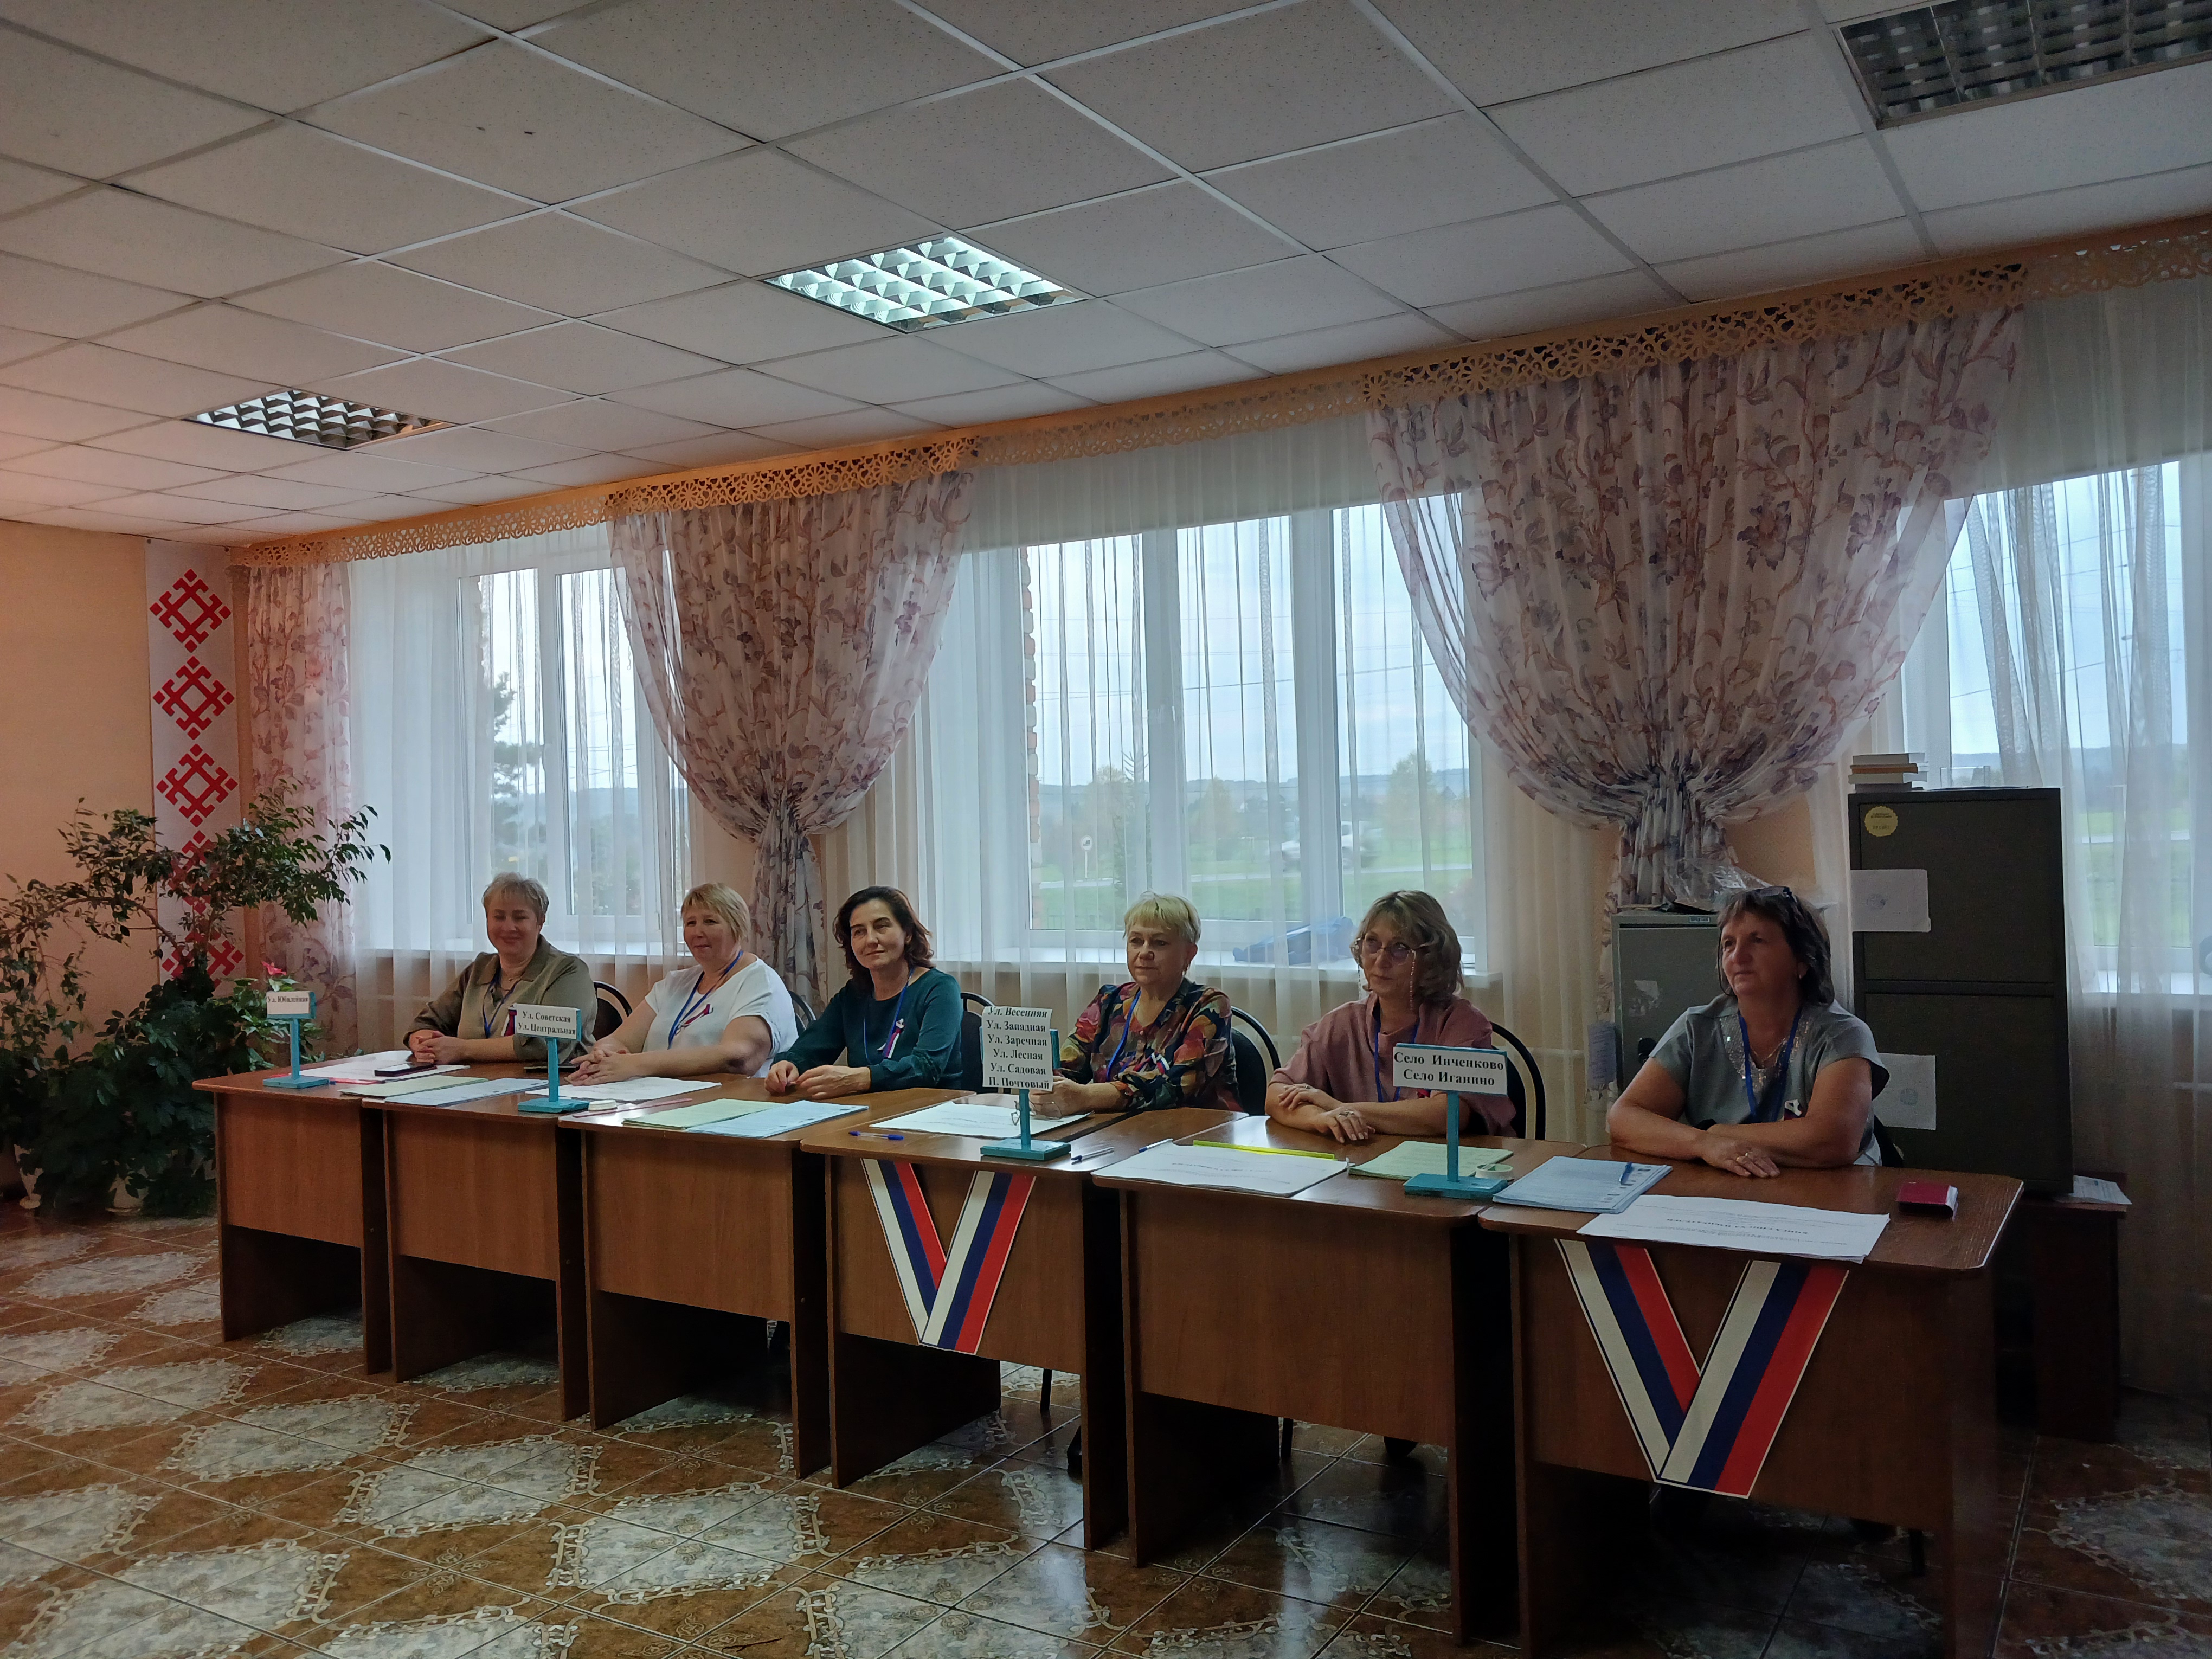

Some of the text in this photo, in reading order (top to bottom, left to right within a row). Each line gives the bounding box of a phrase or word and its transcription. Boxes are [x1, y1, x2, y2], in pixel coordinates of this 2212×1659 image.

[522, 1011, 571, 1023] Ул. Советская
[988, 1007, 1047, 1018] Ул. Весенняя
[518, 1022, 576, 1035] Ул. Центральная
[986, 1020, 1046, 1032] Ул. Западная
[987, 1034, 1047, 1047] Ул. Заречная
[993, 1049, 1043, 1060] Ул. Лесная
[1394, 1052, 1504, 1070] Село Инченково
[990, 1062, 1046, 1075] Ул. Садовая
[988, 1076, 1050, 1090] П. Почтовый
[1403, 1069, 1495, 1086] Село Иганино
